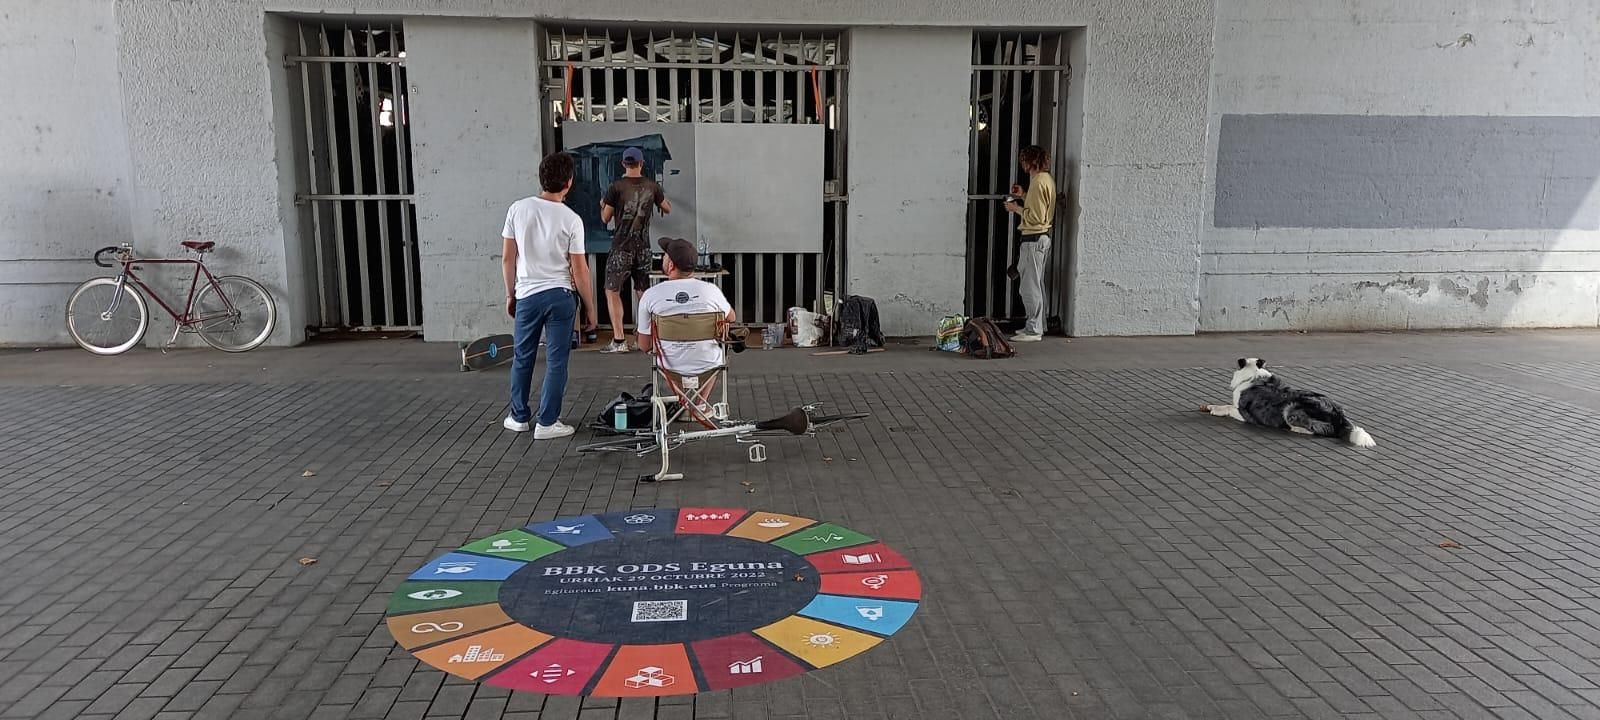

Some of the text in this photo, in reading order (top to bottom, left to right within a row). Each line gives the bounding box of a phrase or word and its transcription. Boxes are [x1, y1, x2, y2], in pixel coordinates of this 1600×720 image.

[543, 562, 784, 576] BBK ODS Eguna
[560, 576, 623, 584] URRIAK
[650, 573, 726, 581] OCTUBRE
[607, 584, 716, 592] kuna.bbk.eus
